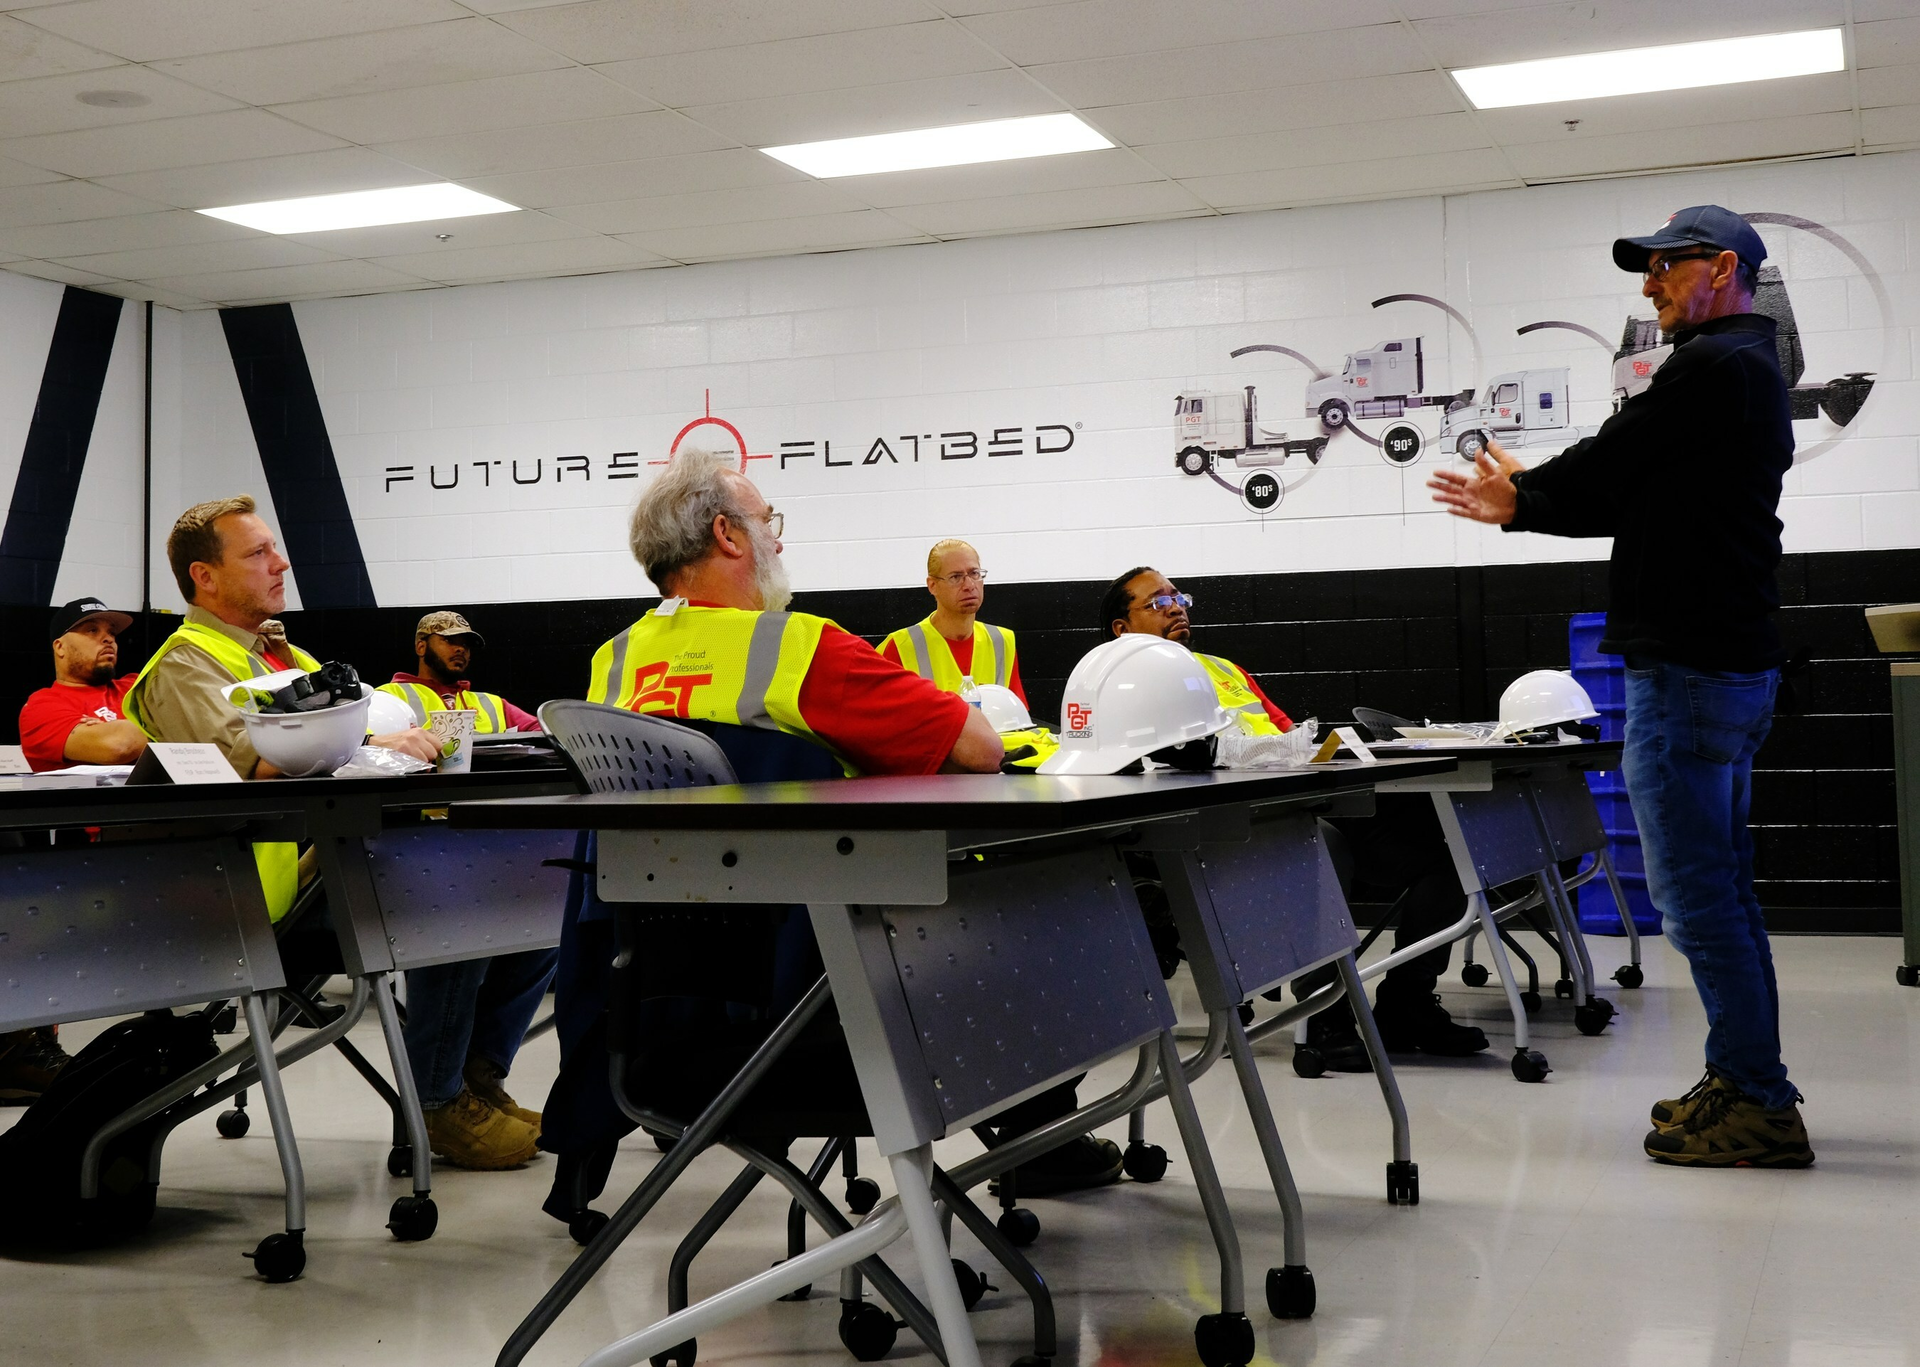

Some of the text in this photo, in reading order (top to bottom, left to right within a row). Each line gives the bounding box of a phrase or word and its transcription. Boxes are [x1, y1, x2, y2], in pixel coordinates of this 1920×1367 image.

[385, 424, 1075, 493] FUTURE FLATBED
[683, 650, 705, 659] Proud
[671, 663, 713, 672] rofessionals
[1067, 703, 1092, 730] PGT
